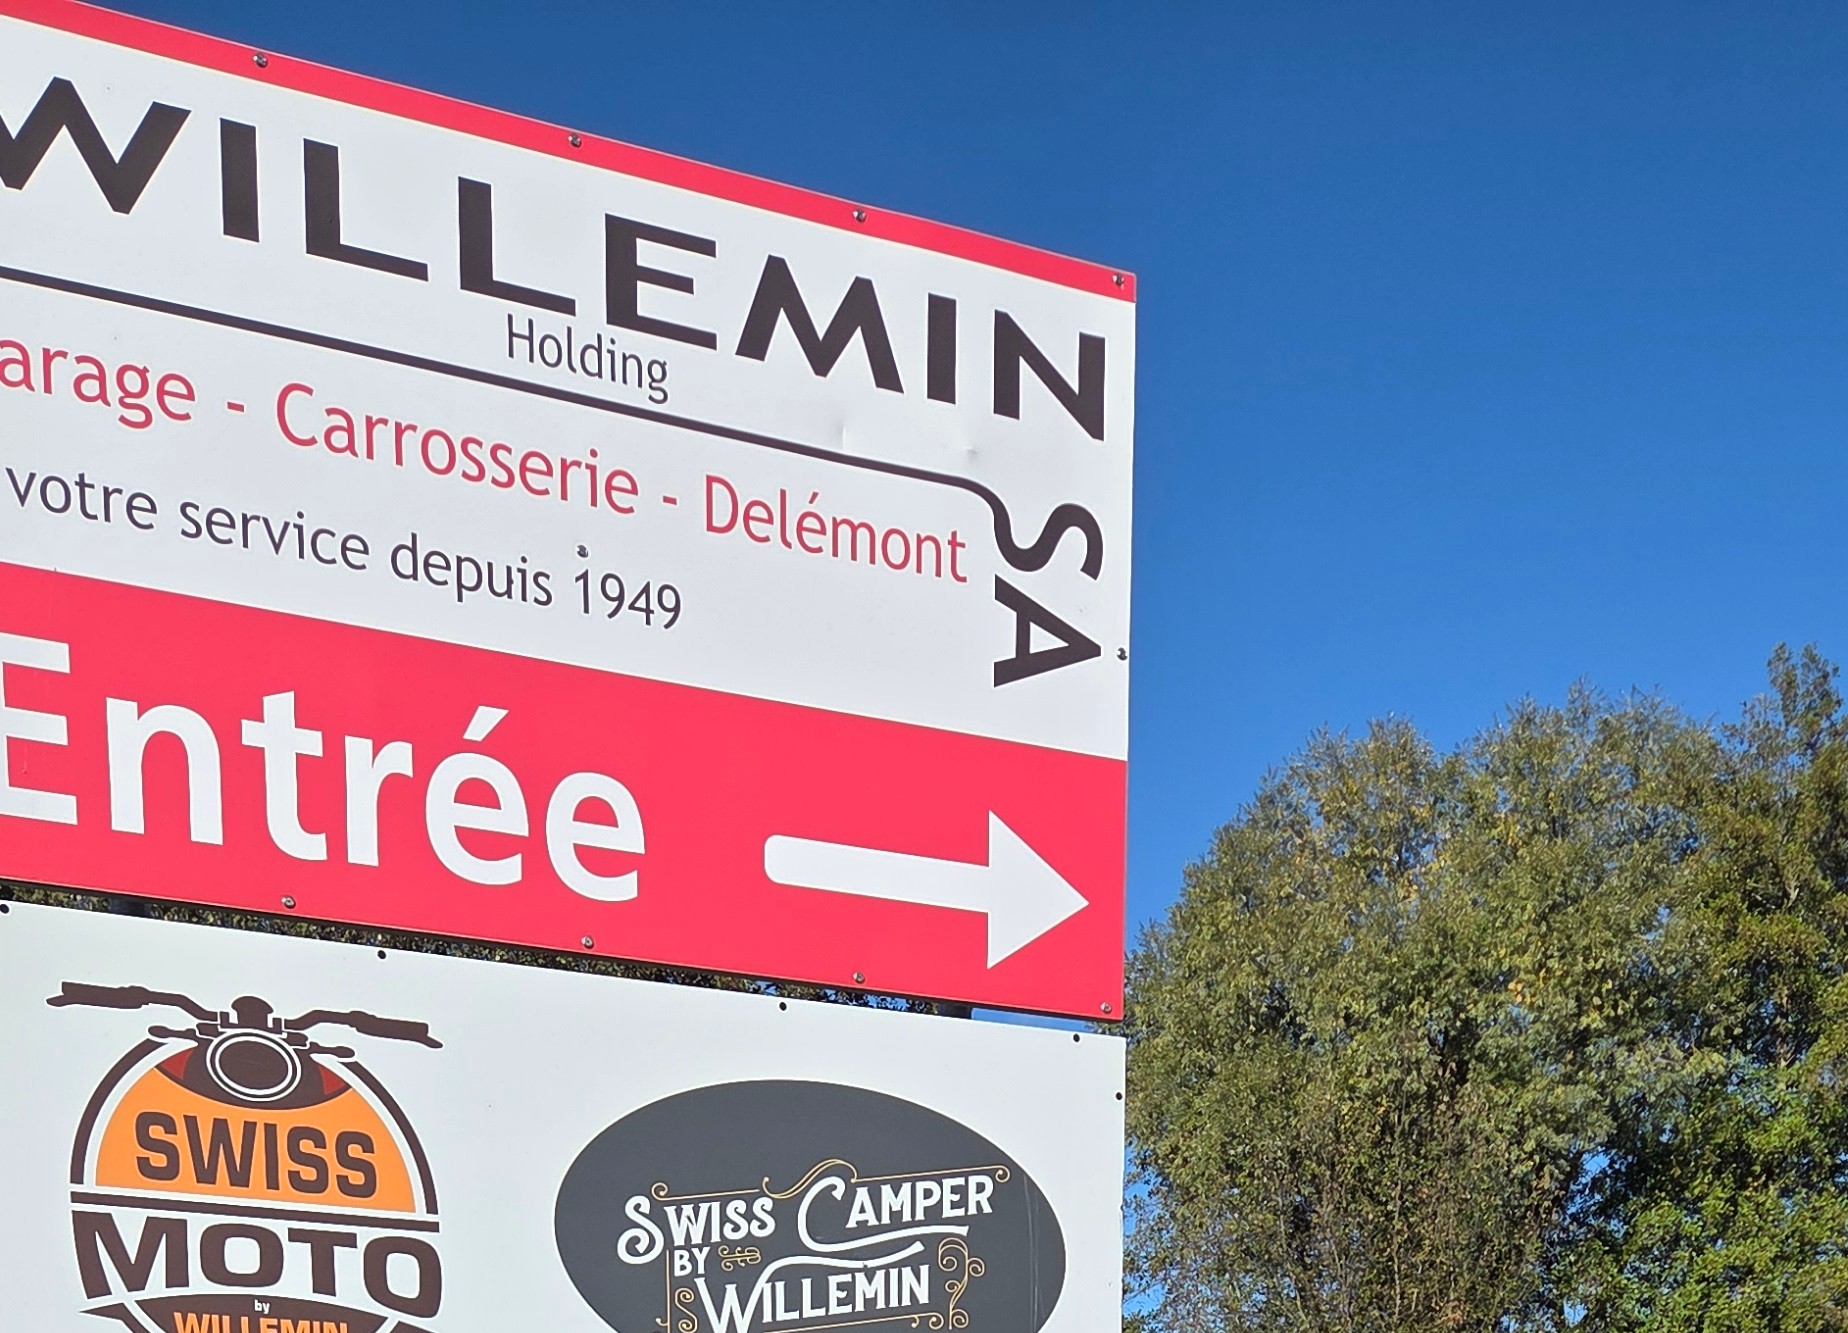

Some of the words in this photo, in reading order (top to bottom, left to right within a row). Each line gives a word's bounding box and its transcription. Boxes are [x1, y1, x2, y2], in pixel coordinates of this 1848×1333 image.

[0, 76, 1106, 442] WILLEMIN
[507, 313, 669, 404] Holding
[276, 382, 640, 514] Carrosserie
[705, 474, 968, 583] Delémont
[5, 467, 158, 530] votre
[179, 500, 370, 571] service
[390, 532, 553, 607] depuis
[574, 568, 682, 630] 1949
[994, 502, 1104, 688] SA
[0, 631, 647, 902] Entrée
[135, 1111, 378, 1199] SWISS
[71, 1210, 443, 1319] MOTO
[616, 1194, 776, 1264] SWISS
[798, 1175, 994, 1252] CAMPER
[674, 1247, 710, 1277] BY
[254, 1299, 270, 1314] by
